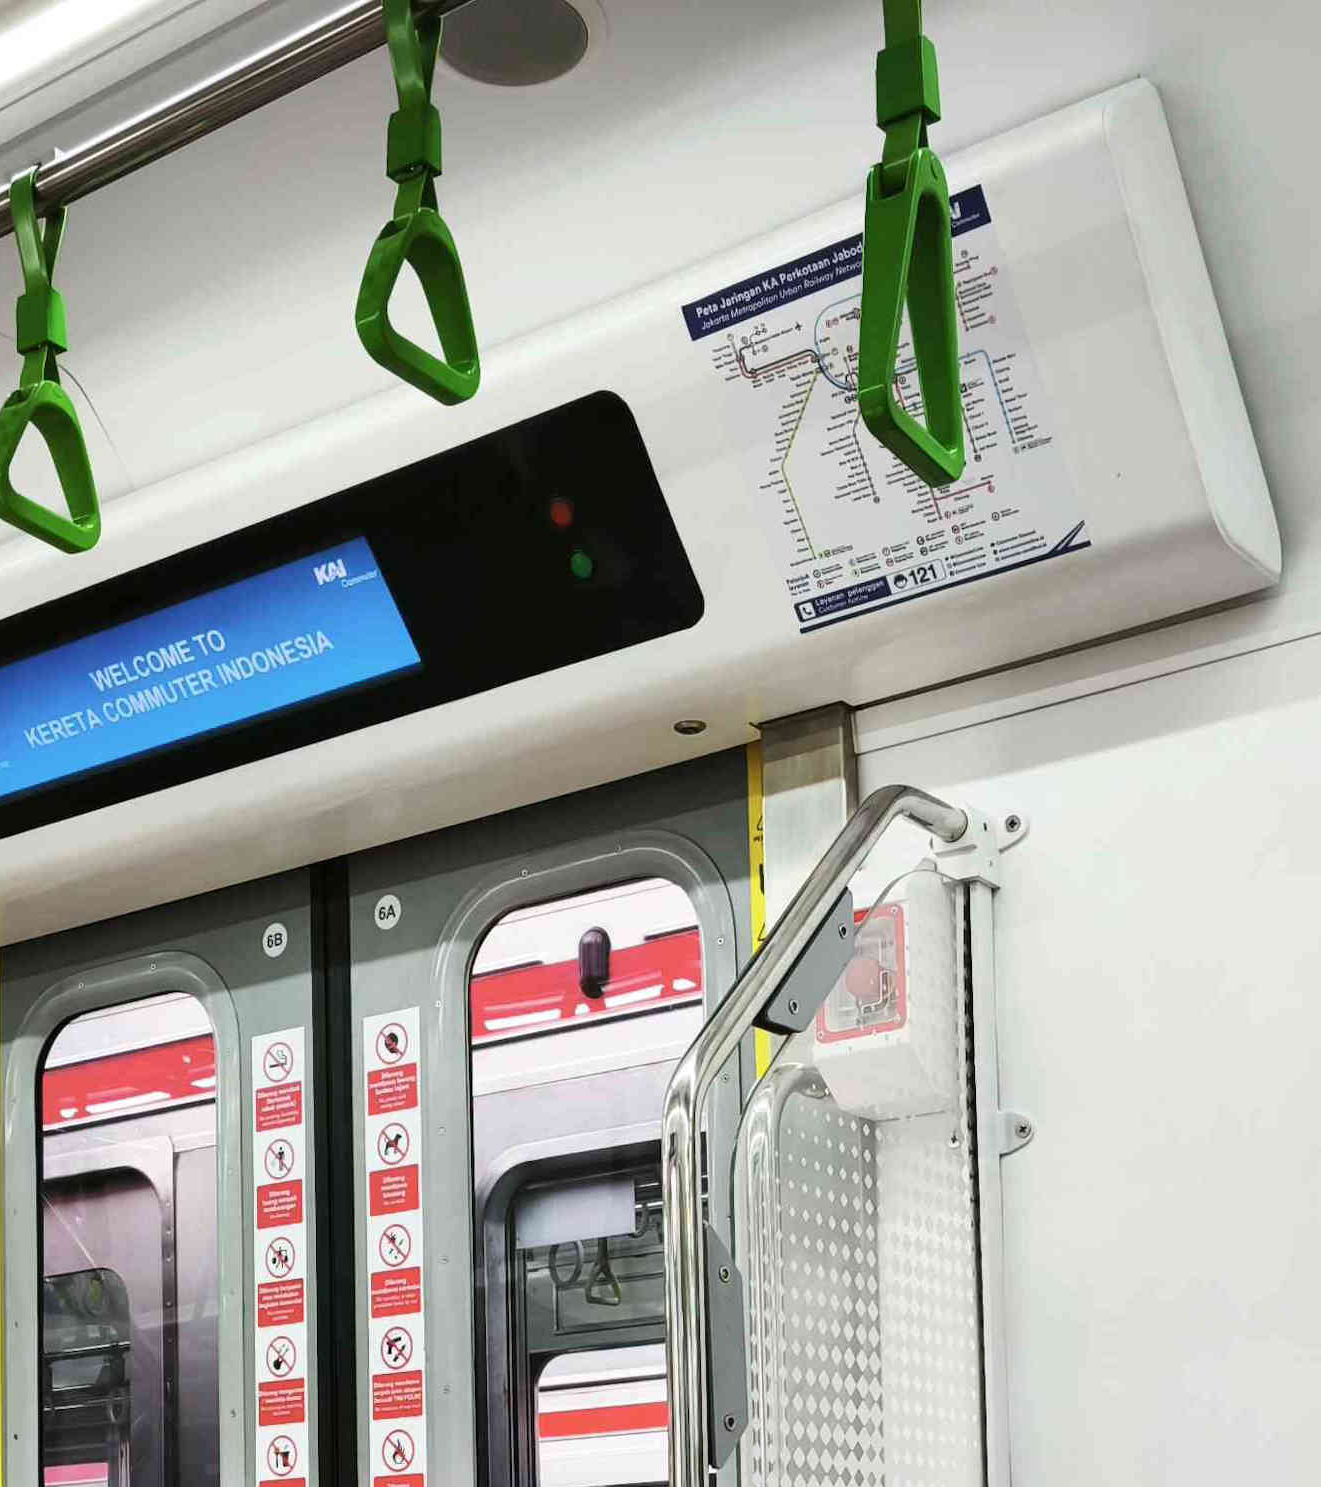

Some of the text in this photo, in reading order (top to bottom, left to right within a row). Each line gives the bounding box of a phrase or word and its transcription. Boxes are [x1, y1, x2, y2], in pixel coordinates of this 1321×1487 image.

[695, 241, 863, 318] Peta Jaringan KA Perkotaan Jabod
[701, 259, 863, 331] Jakarta Metropolitan Urban Railway Netwo
[312, 558, 347, 586] KAI
[909, 564, 938, 585] 121
[88, 629, 227, 692] WELCOME TO
[24, 630, 335, 749] KERETA COMMUTER INDONESIA
[378, 903, 396, 921] 6A
[266, 932, 283, 949] 6B
